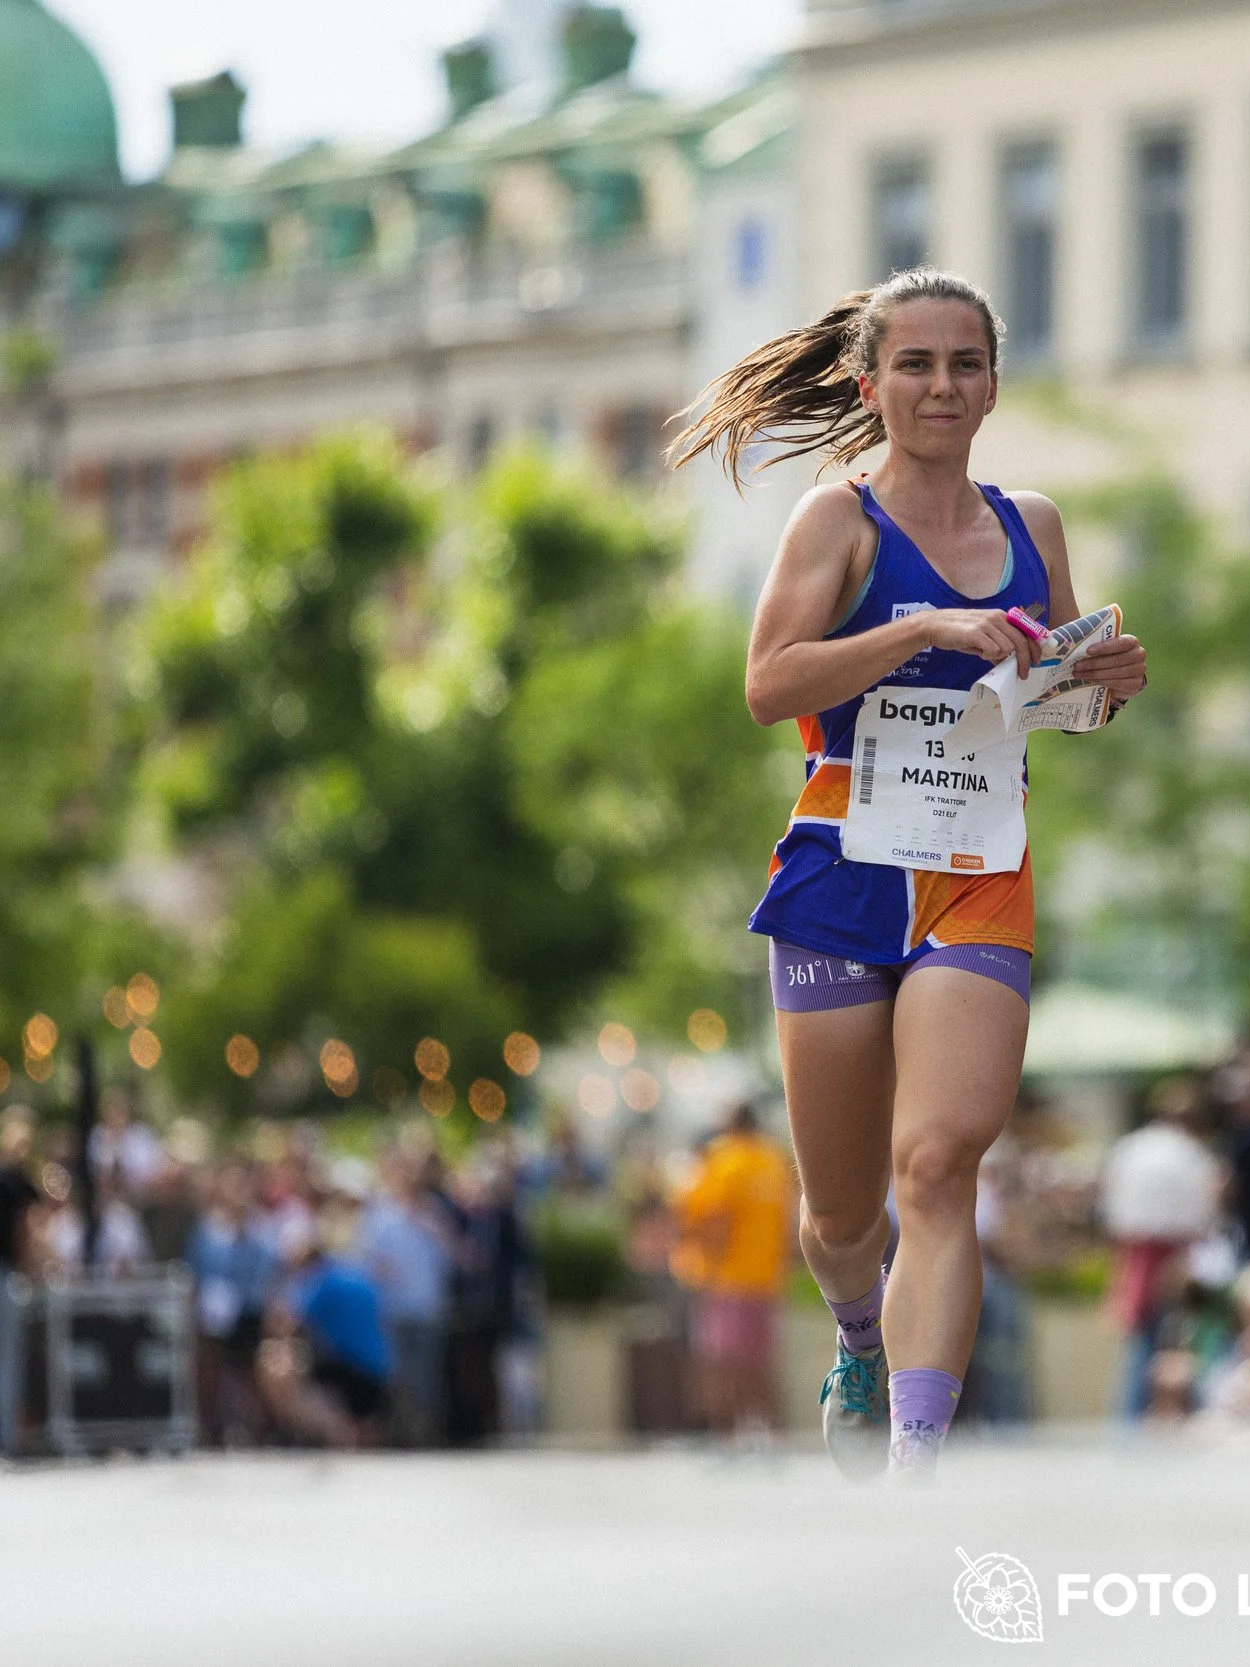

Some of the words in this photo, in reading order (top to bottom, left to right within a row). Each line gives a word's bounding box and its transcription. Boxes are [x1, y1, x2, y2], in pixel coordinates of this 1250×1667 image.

[1088, 686, 1106, 728] CHALMERS
[901, 766, 989, 793] MARTINA
[924, 795, 936, 803] IFK
[937, 796, 967, 807] TRATTORE
[891, 848, 942, 861] CHALMERS
